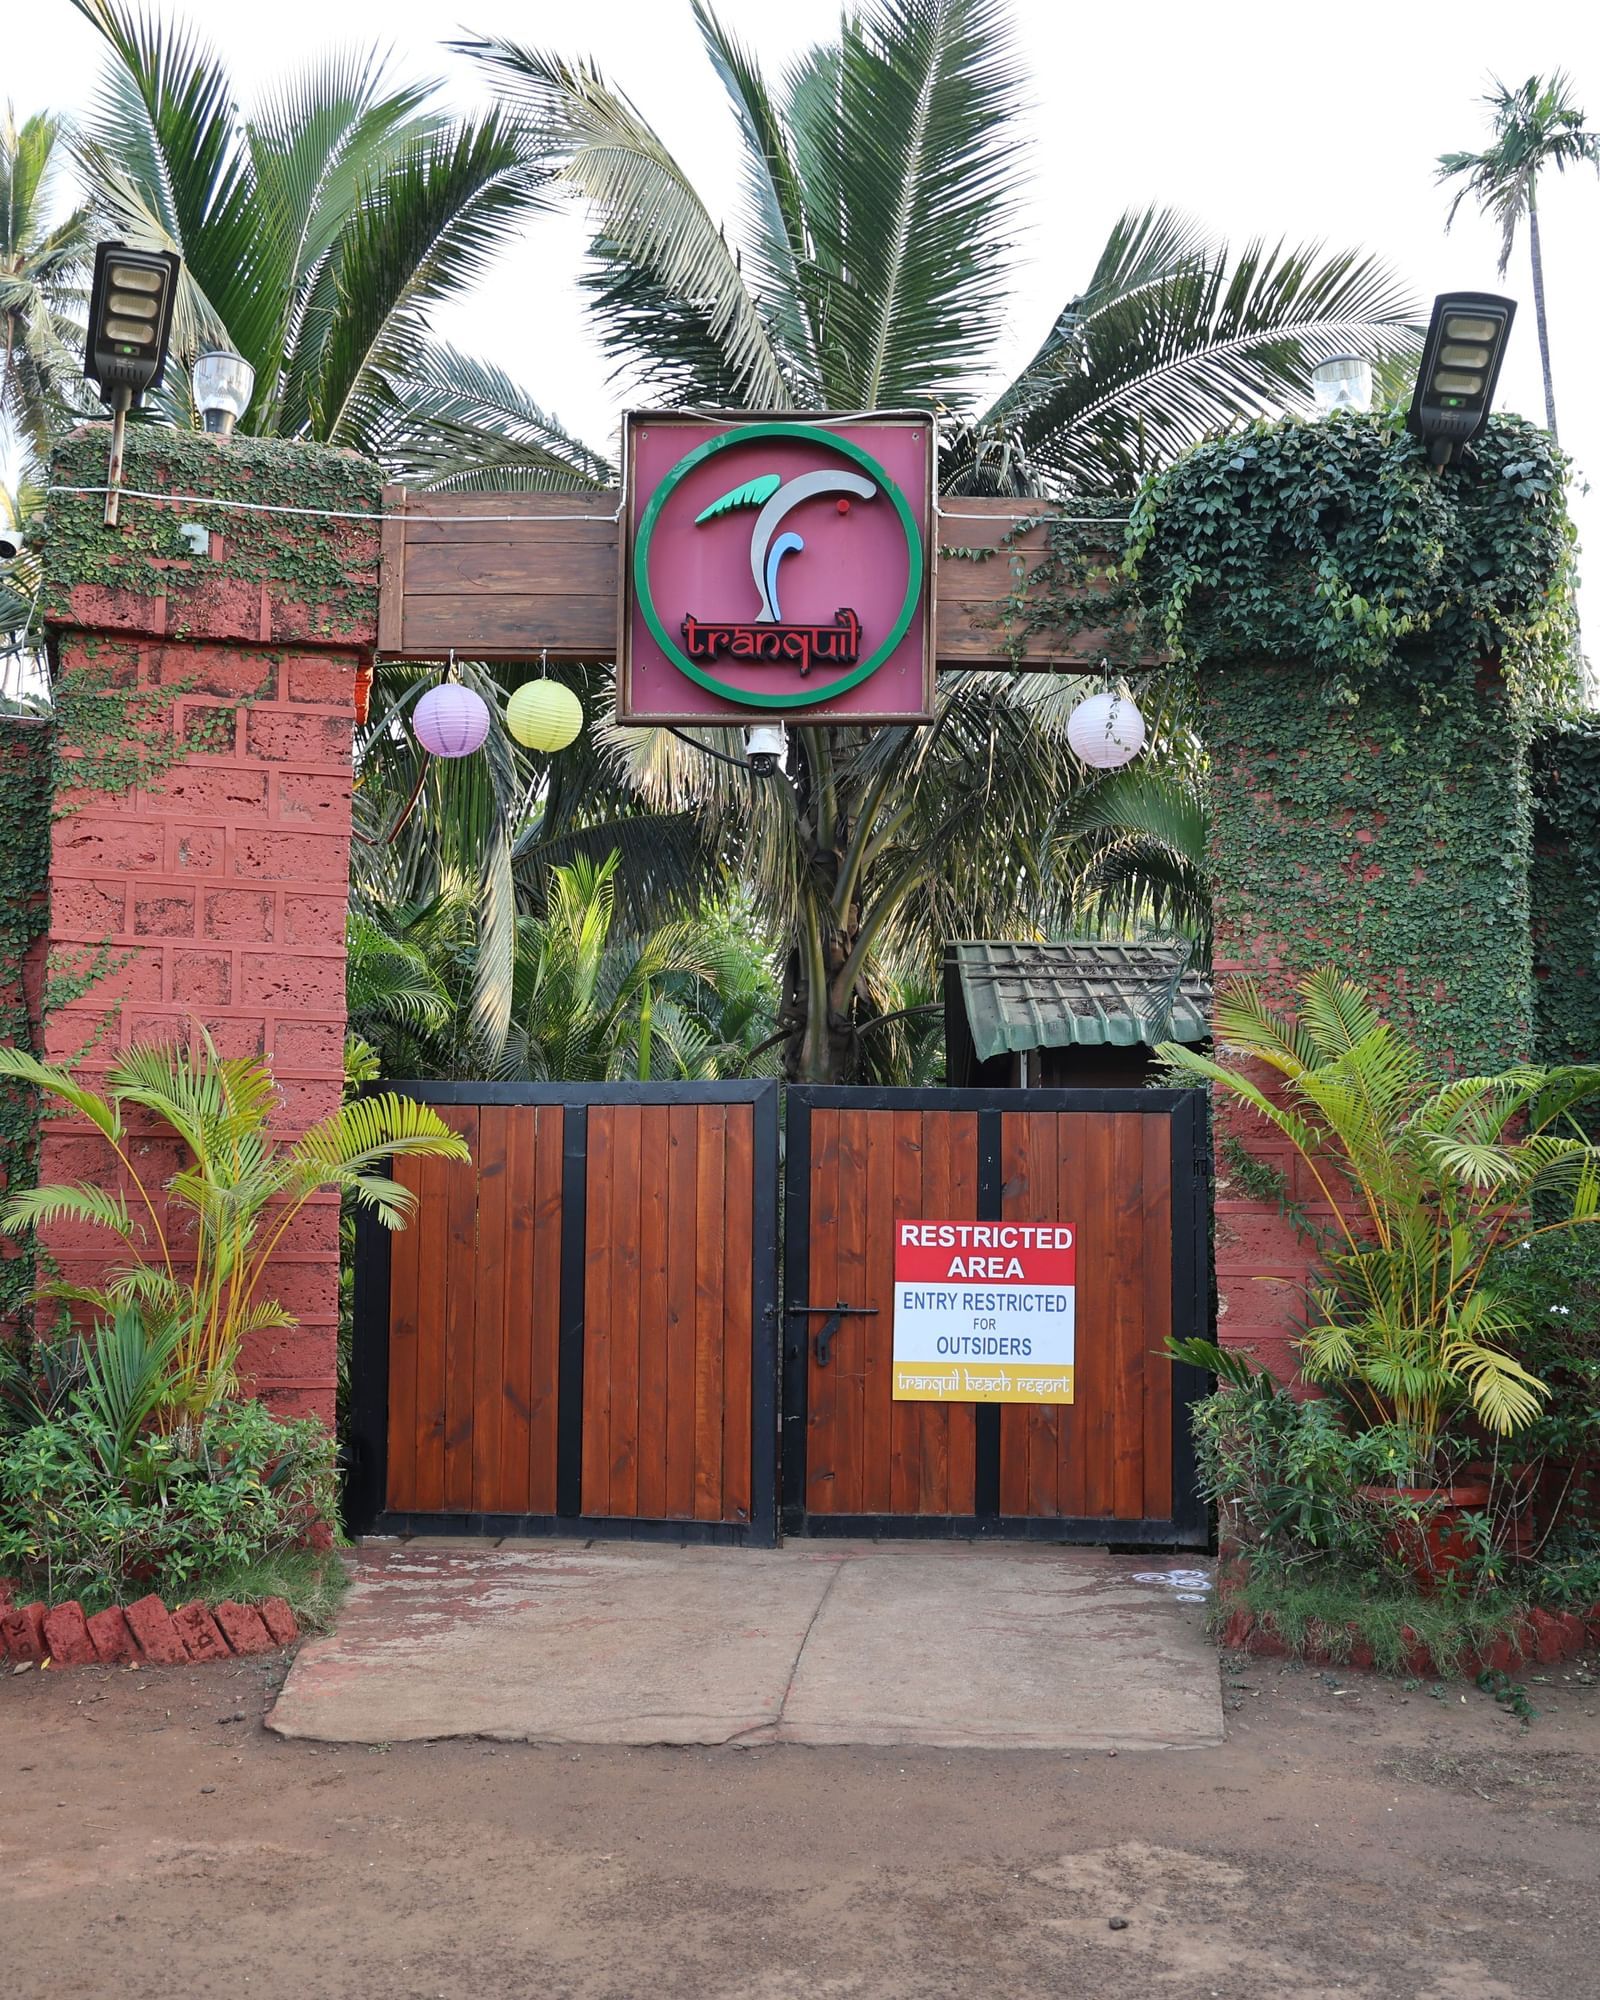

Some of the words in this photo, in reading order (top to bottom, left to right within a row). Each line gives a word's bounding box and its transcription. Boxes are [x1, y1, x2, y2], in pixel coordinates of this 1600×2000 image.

[681, 608, 862, 677] tranquil
[901, 1225, 1073, 1249] RESTRICTED
[947, 1256, 1025, 1279] AREA
[903, 1291, 958, 1310] ENTRY
[963, 1293, 1067, 1312] RESTRICTED
[973, 1318, 996, 1330] FOR
[936, 1336, 1032, 1355] OUTSIDERS
[898, 1369, 960, 1396] tranquil
[964, 1369, 1012, 1391] beach
[1016, 1375, 1070, 1395] resort
